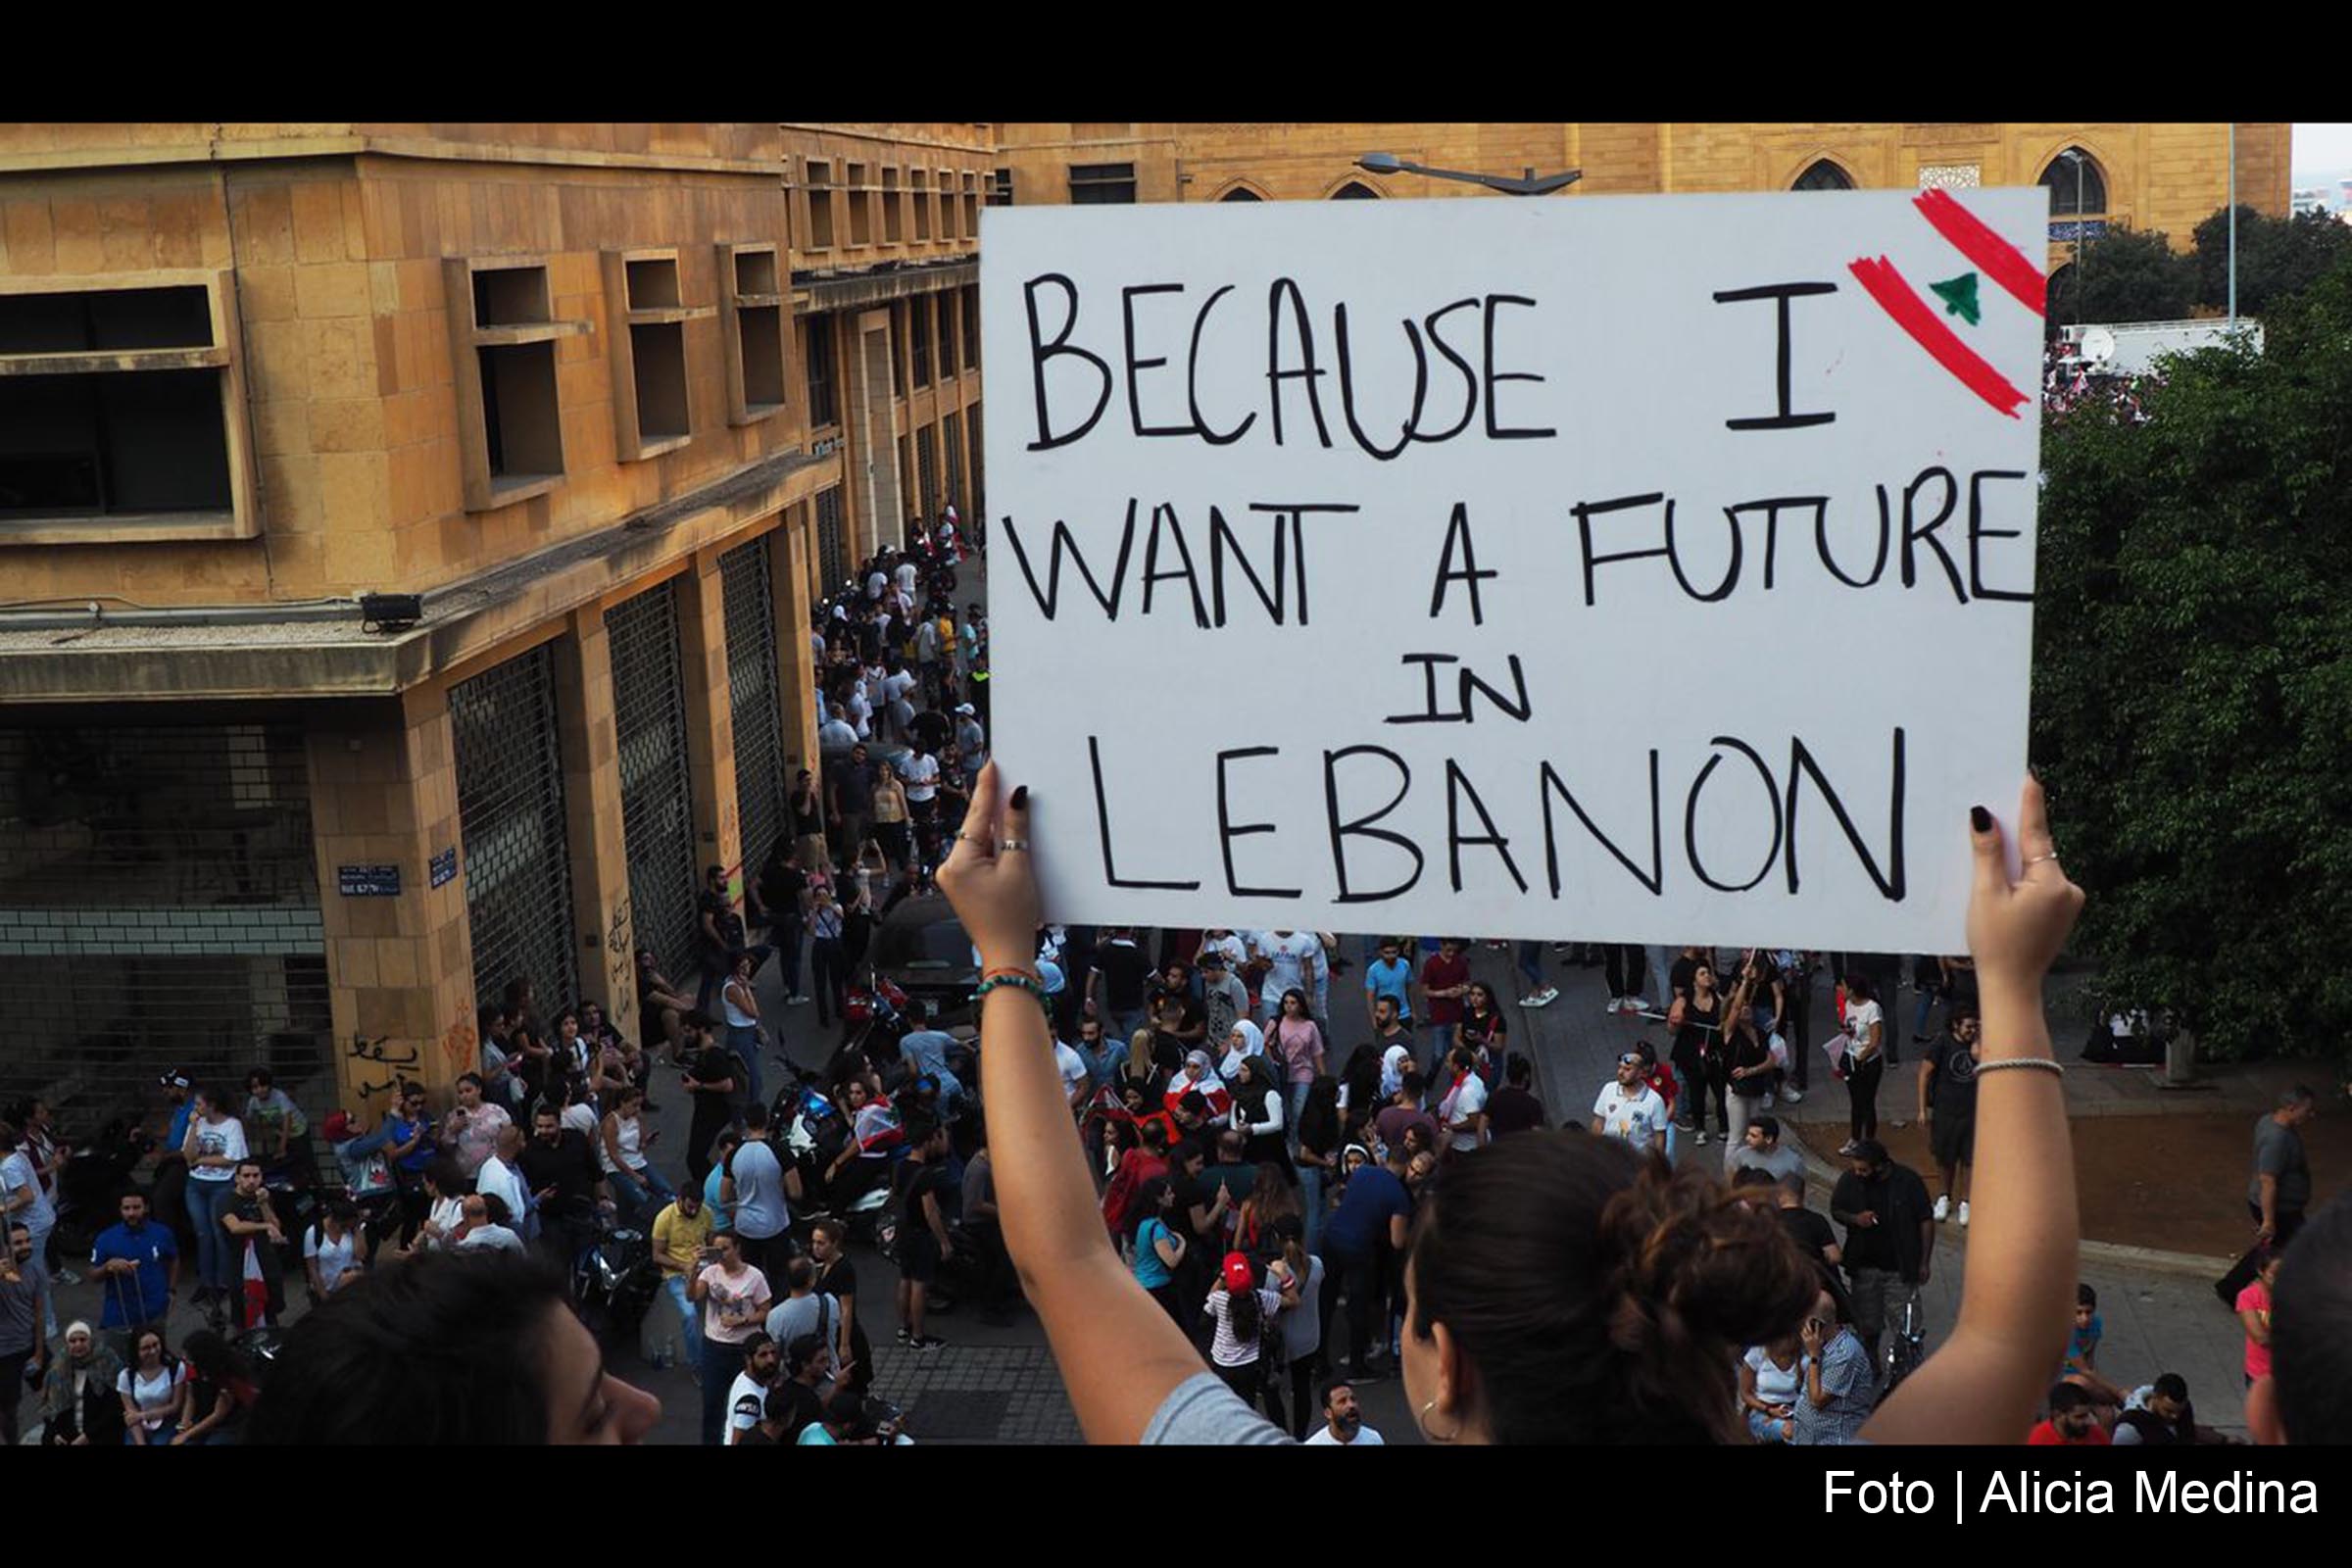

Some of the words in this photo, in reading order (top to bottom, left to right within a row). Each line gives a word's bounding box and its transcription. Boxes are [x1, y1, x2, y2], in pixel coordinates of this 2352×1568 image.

[1023, 272, 1557, 462] BECAUSE
[1712, 281, 1838, 431] I
[1001, 497, 1360, 630] WANT
[1429, 502, 1498, 626] A
[1569, 466, 2034, 606] FUTURE
[1383, 653, 1533, 725] IN
[1088, 726, 1907, 905] LEBANON
